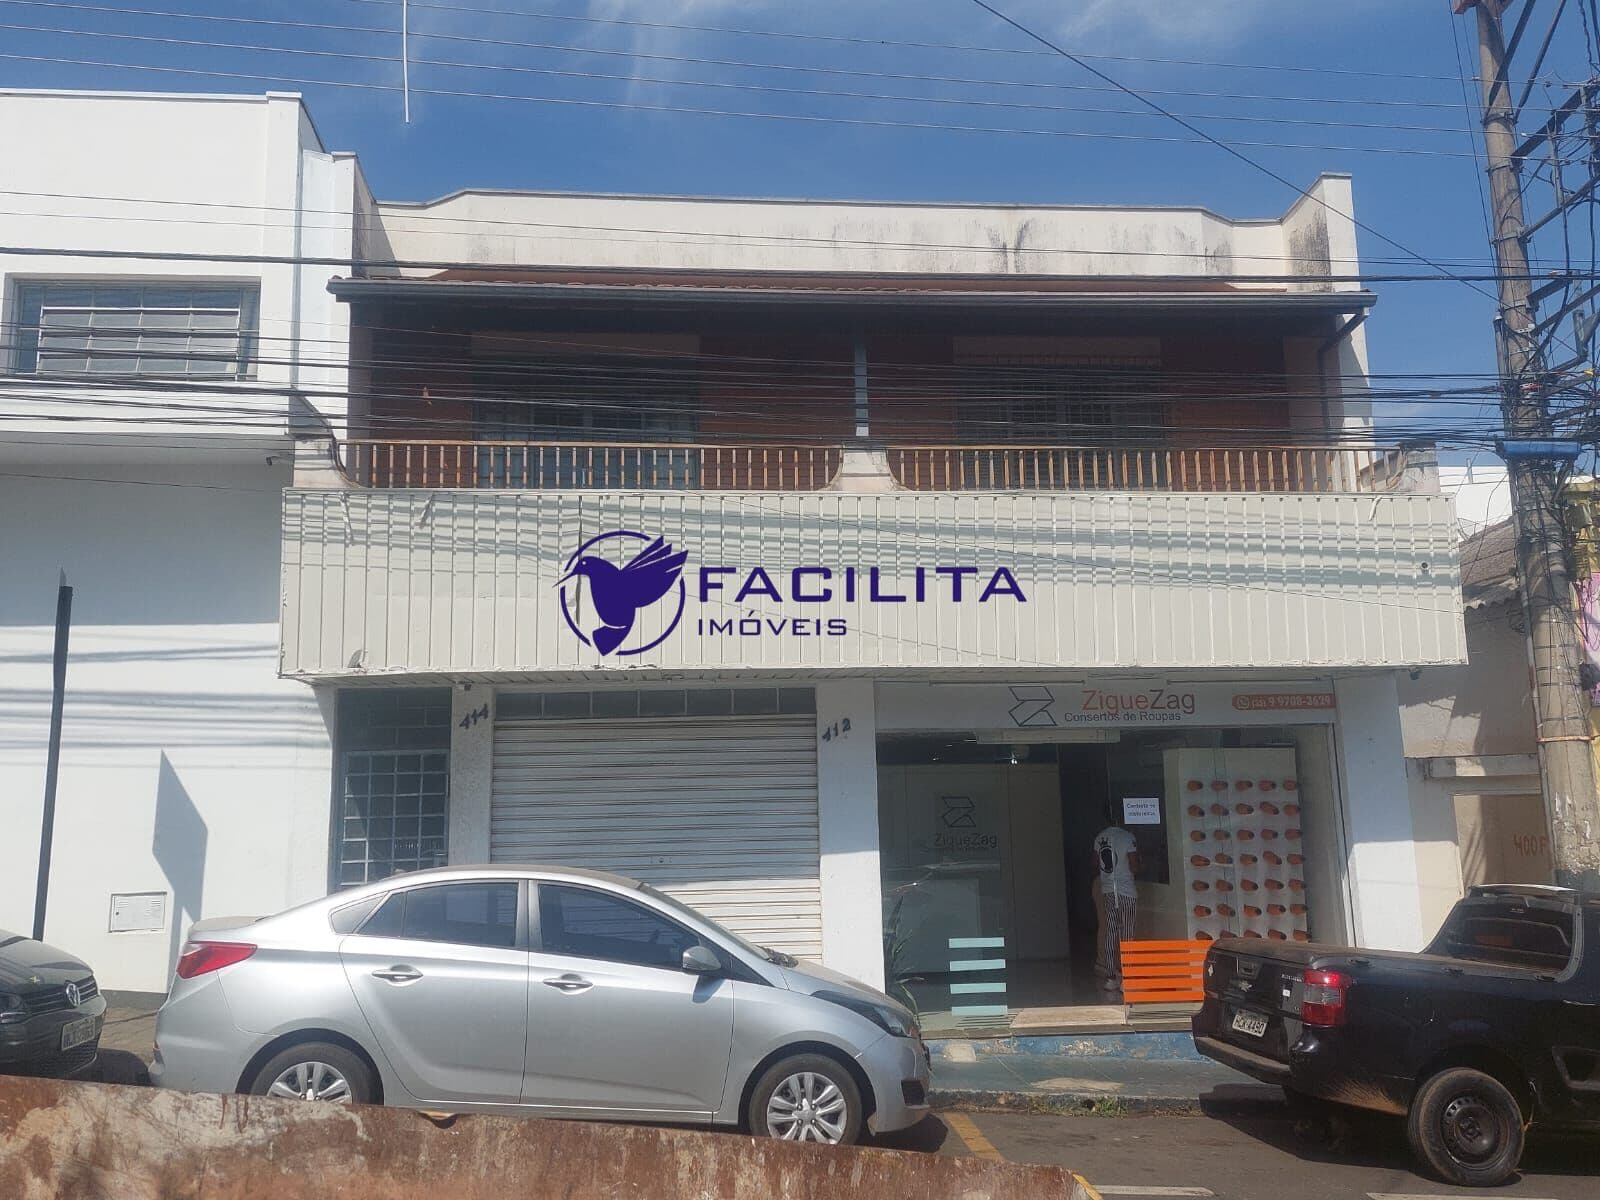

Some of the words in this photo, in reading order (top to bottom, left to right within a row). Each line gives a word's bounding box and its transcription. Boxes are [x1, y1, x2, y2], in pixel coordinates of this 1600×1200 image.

[1082, 689, 1195, 714] ZigueZag
[459, 703, 489, 729] 414
[1064, 712, 1120, 722] Consertos
[1123, 711, 1136, 721] de
[1140, 711, 1181, 723] Roupas
[822, 718, 851, 742] 412
